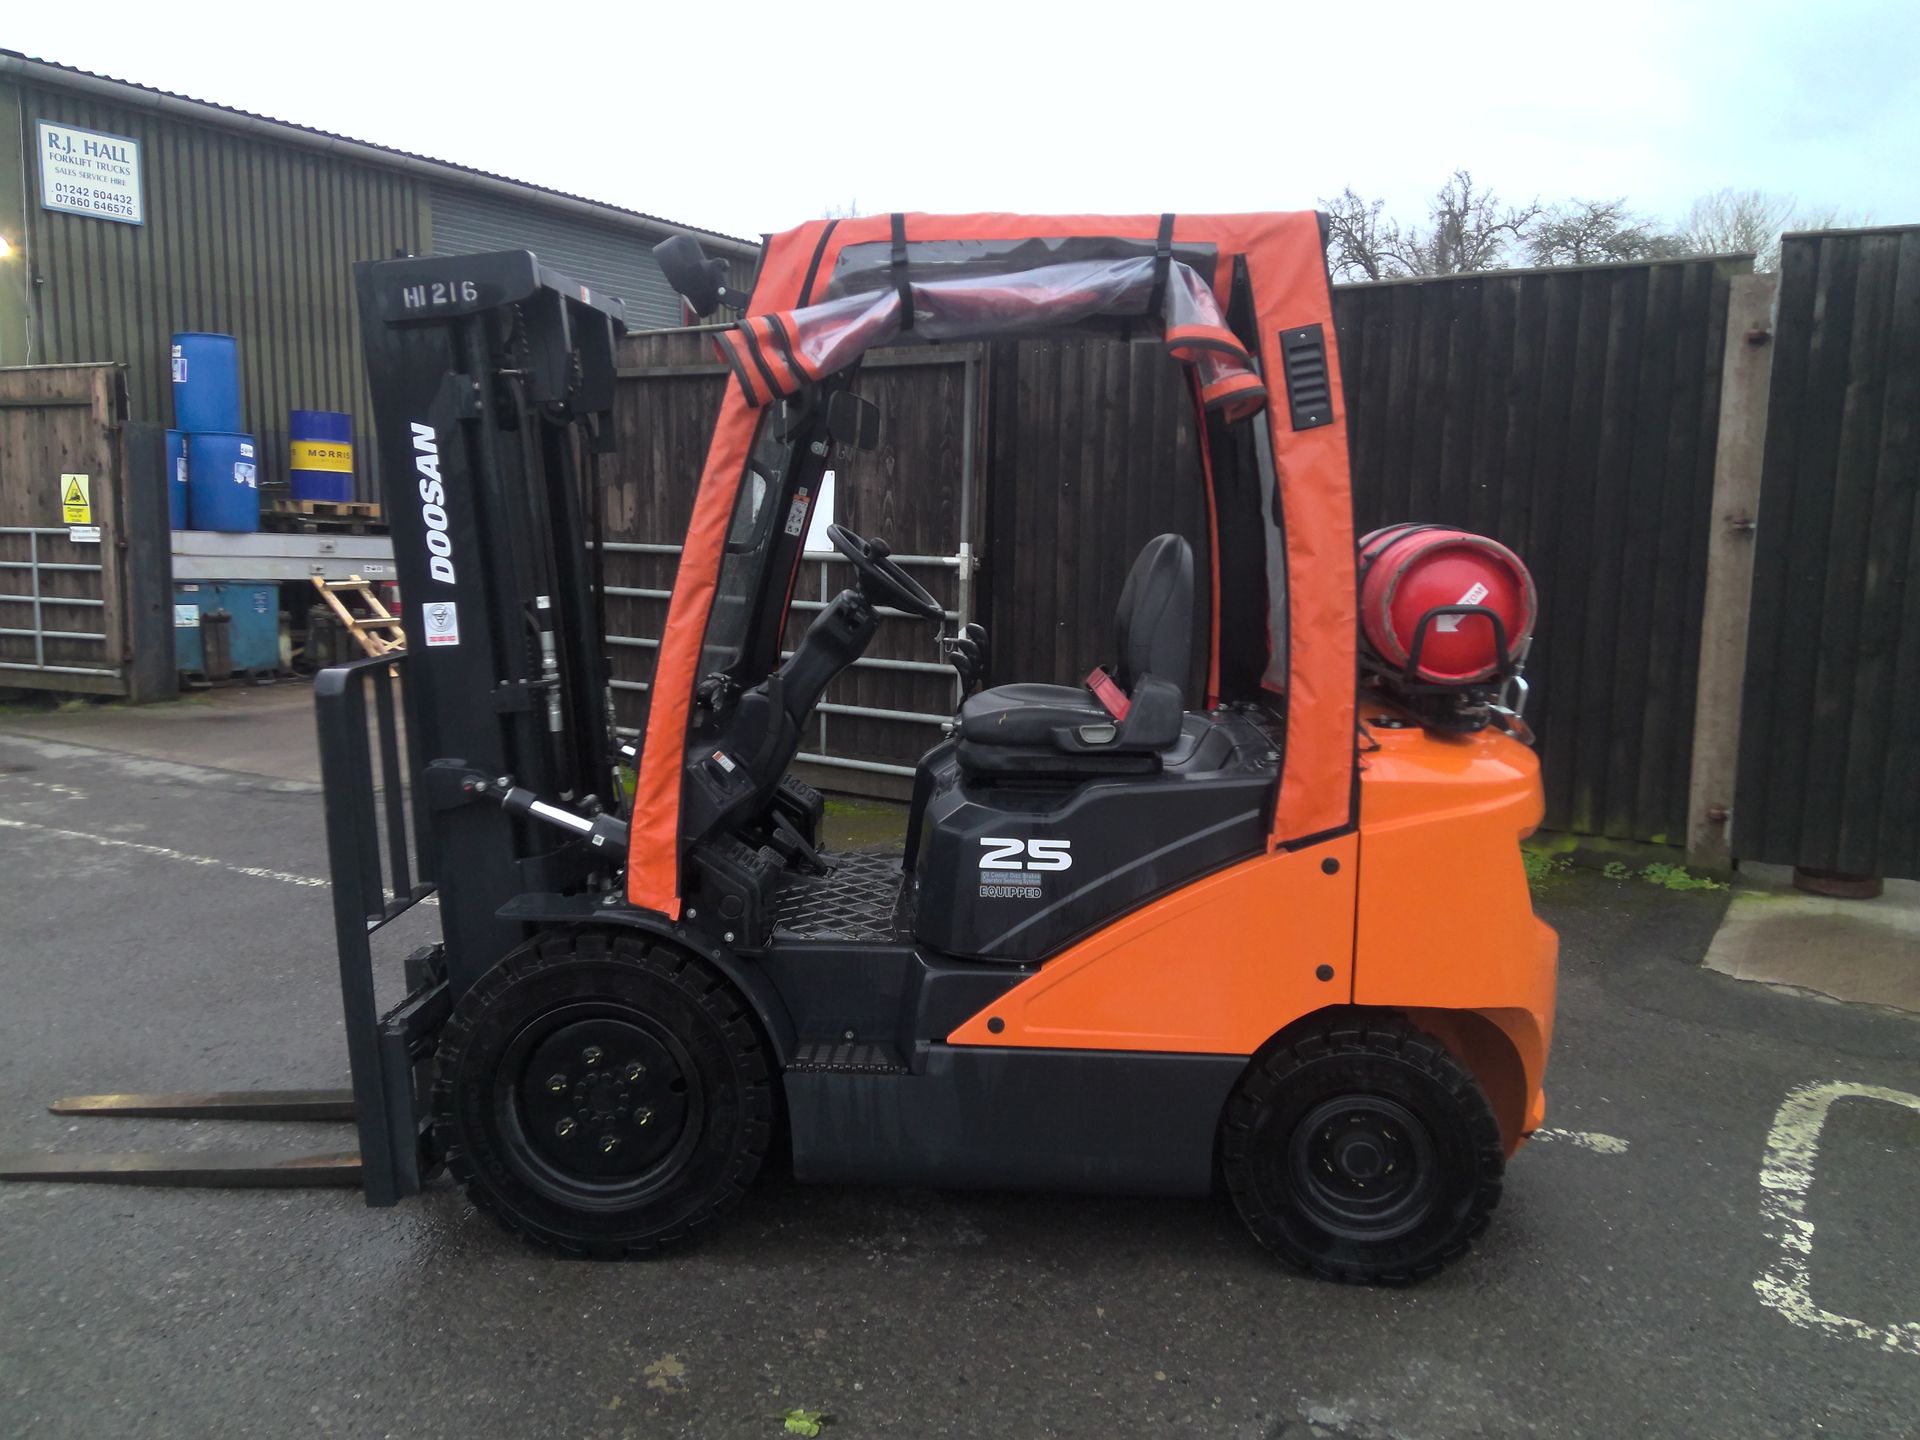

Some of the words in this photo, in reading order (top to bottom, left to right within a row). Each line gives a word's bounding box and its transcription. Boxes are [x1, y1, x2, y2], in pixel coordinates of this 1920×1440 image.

[48, 132, 76, 154] R.J.
[84, 139, 130, 163] HALL
[49, 152, 92, 168] FORKLIFT
[97, 161, 131, 175] TRUCKS
[54, 166, 77, 177] SALES
[79, 171, 108, 183] SERVICE
[110, 177, 126, 187] HIRE
[55, 182, 90, 197] 01242
[93, 189, 133, 205] 604432
[55, 194, 90, 208] 07860
[94, 201, 133, 216] 646576
[410, 422, 456, 585] DOOSAN
[979, 837, 1073, 871] 25
[979, 885, 1042, 898] EQUIPPED
